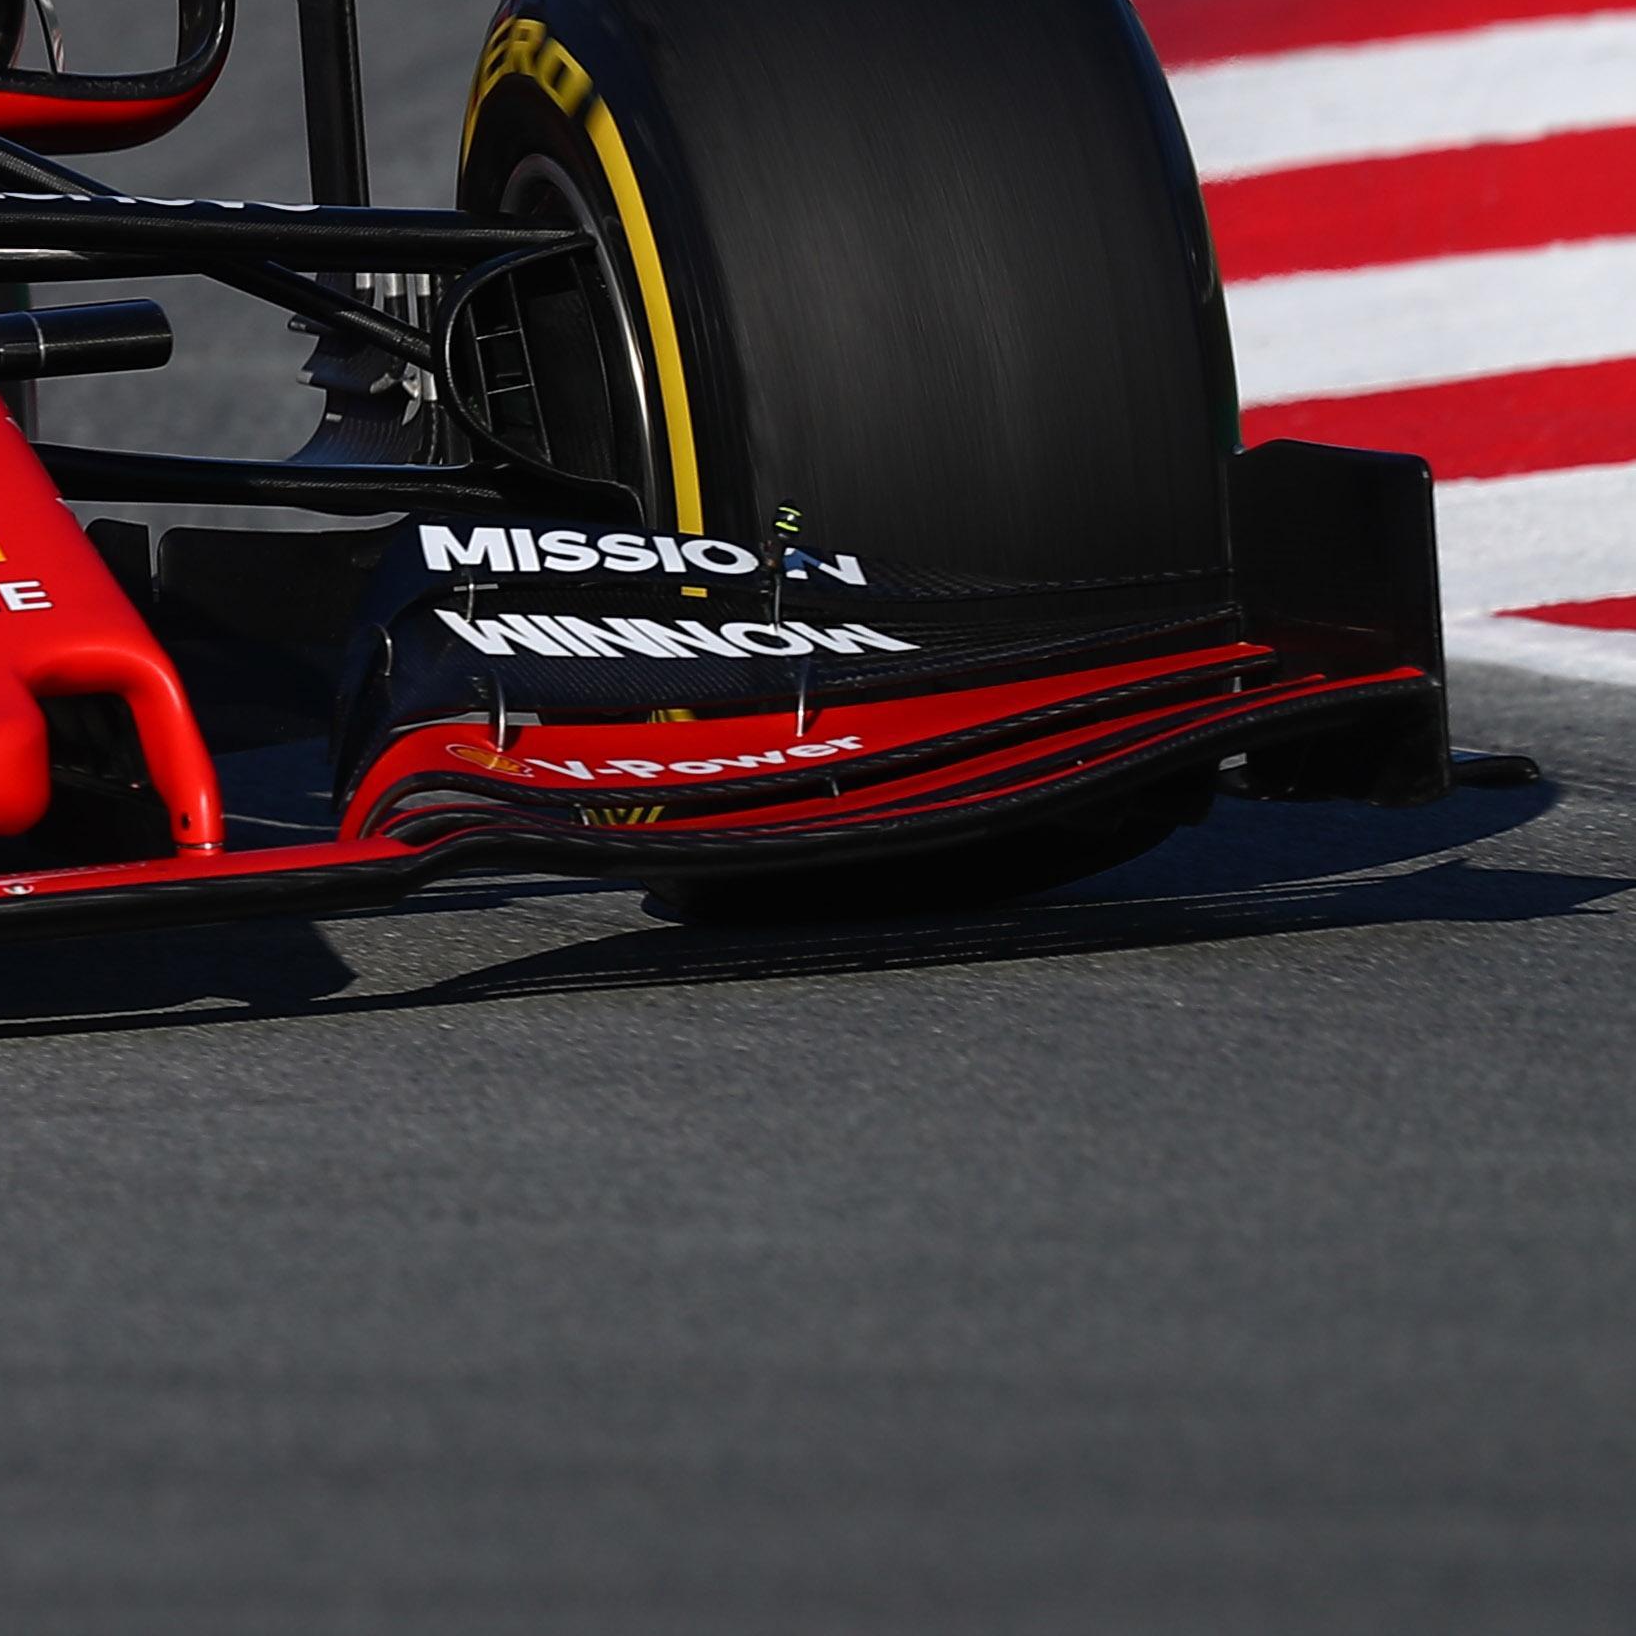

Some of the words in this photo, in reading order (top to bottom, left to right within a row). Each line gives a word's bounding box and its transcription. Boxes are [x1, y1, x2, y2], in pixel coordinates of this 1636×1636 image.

[417, 524, 868, 587] MISSION
[432, 608, 923, 659] WINNOW
[530, 732, 865, 782] V-Power
